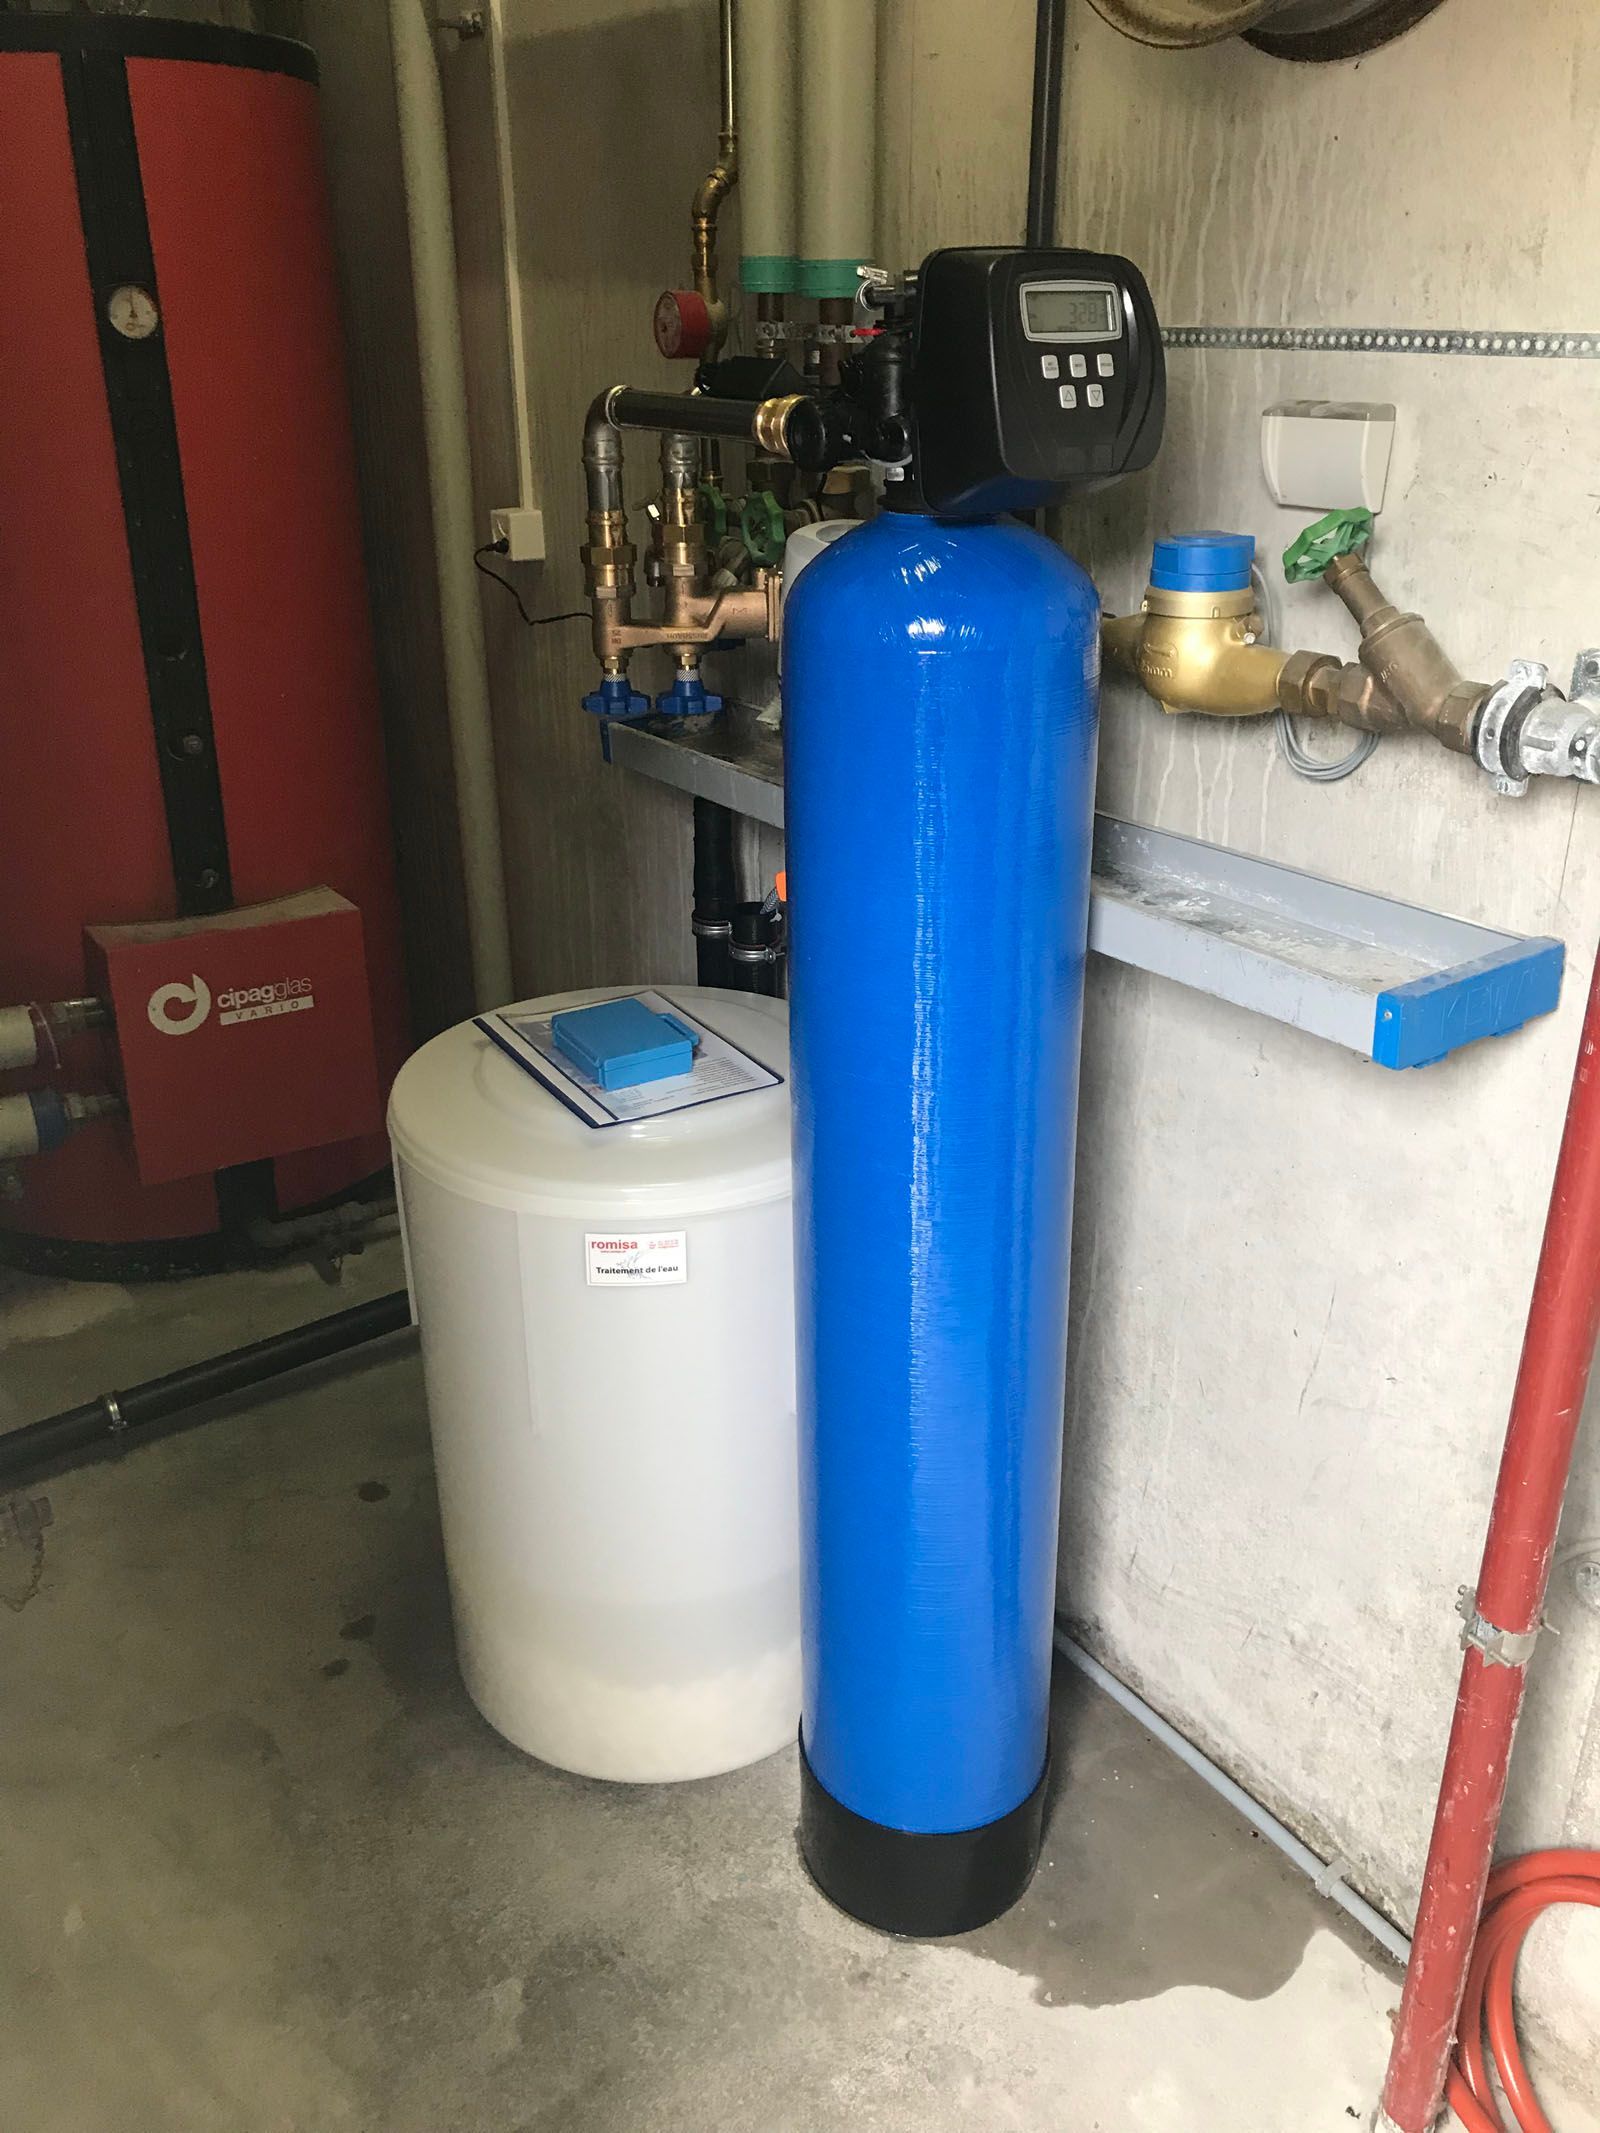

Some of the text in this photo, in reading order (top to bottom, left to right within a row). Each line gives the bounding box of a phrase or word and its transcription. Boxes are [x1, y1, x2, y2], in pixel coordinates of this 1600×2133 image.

[235, 1000, 300, 1020] VARIO
[591, 1239, 638, 1250] romisa
[596, 1265, 679, 1275] Traitement de l'eau
